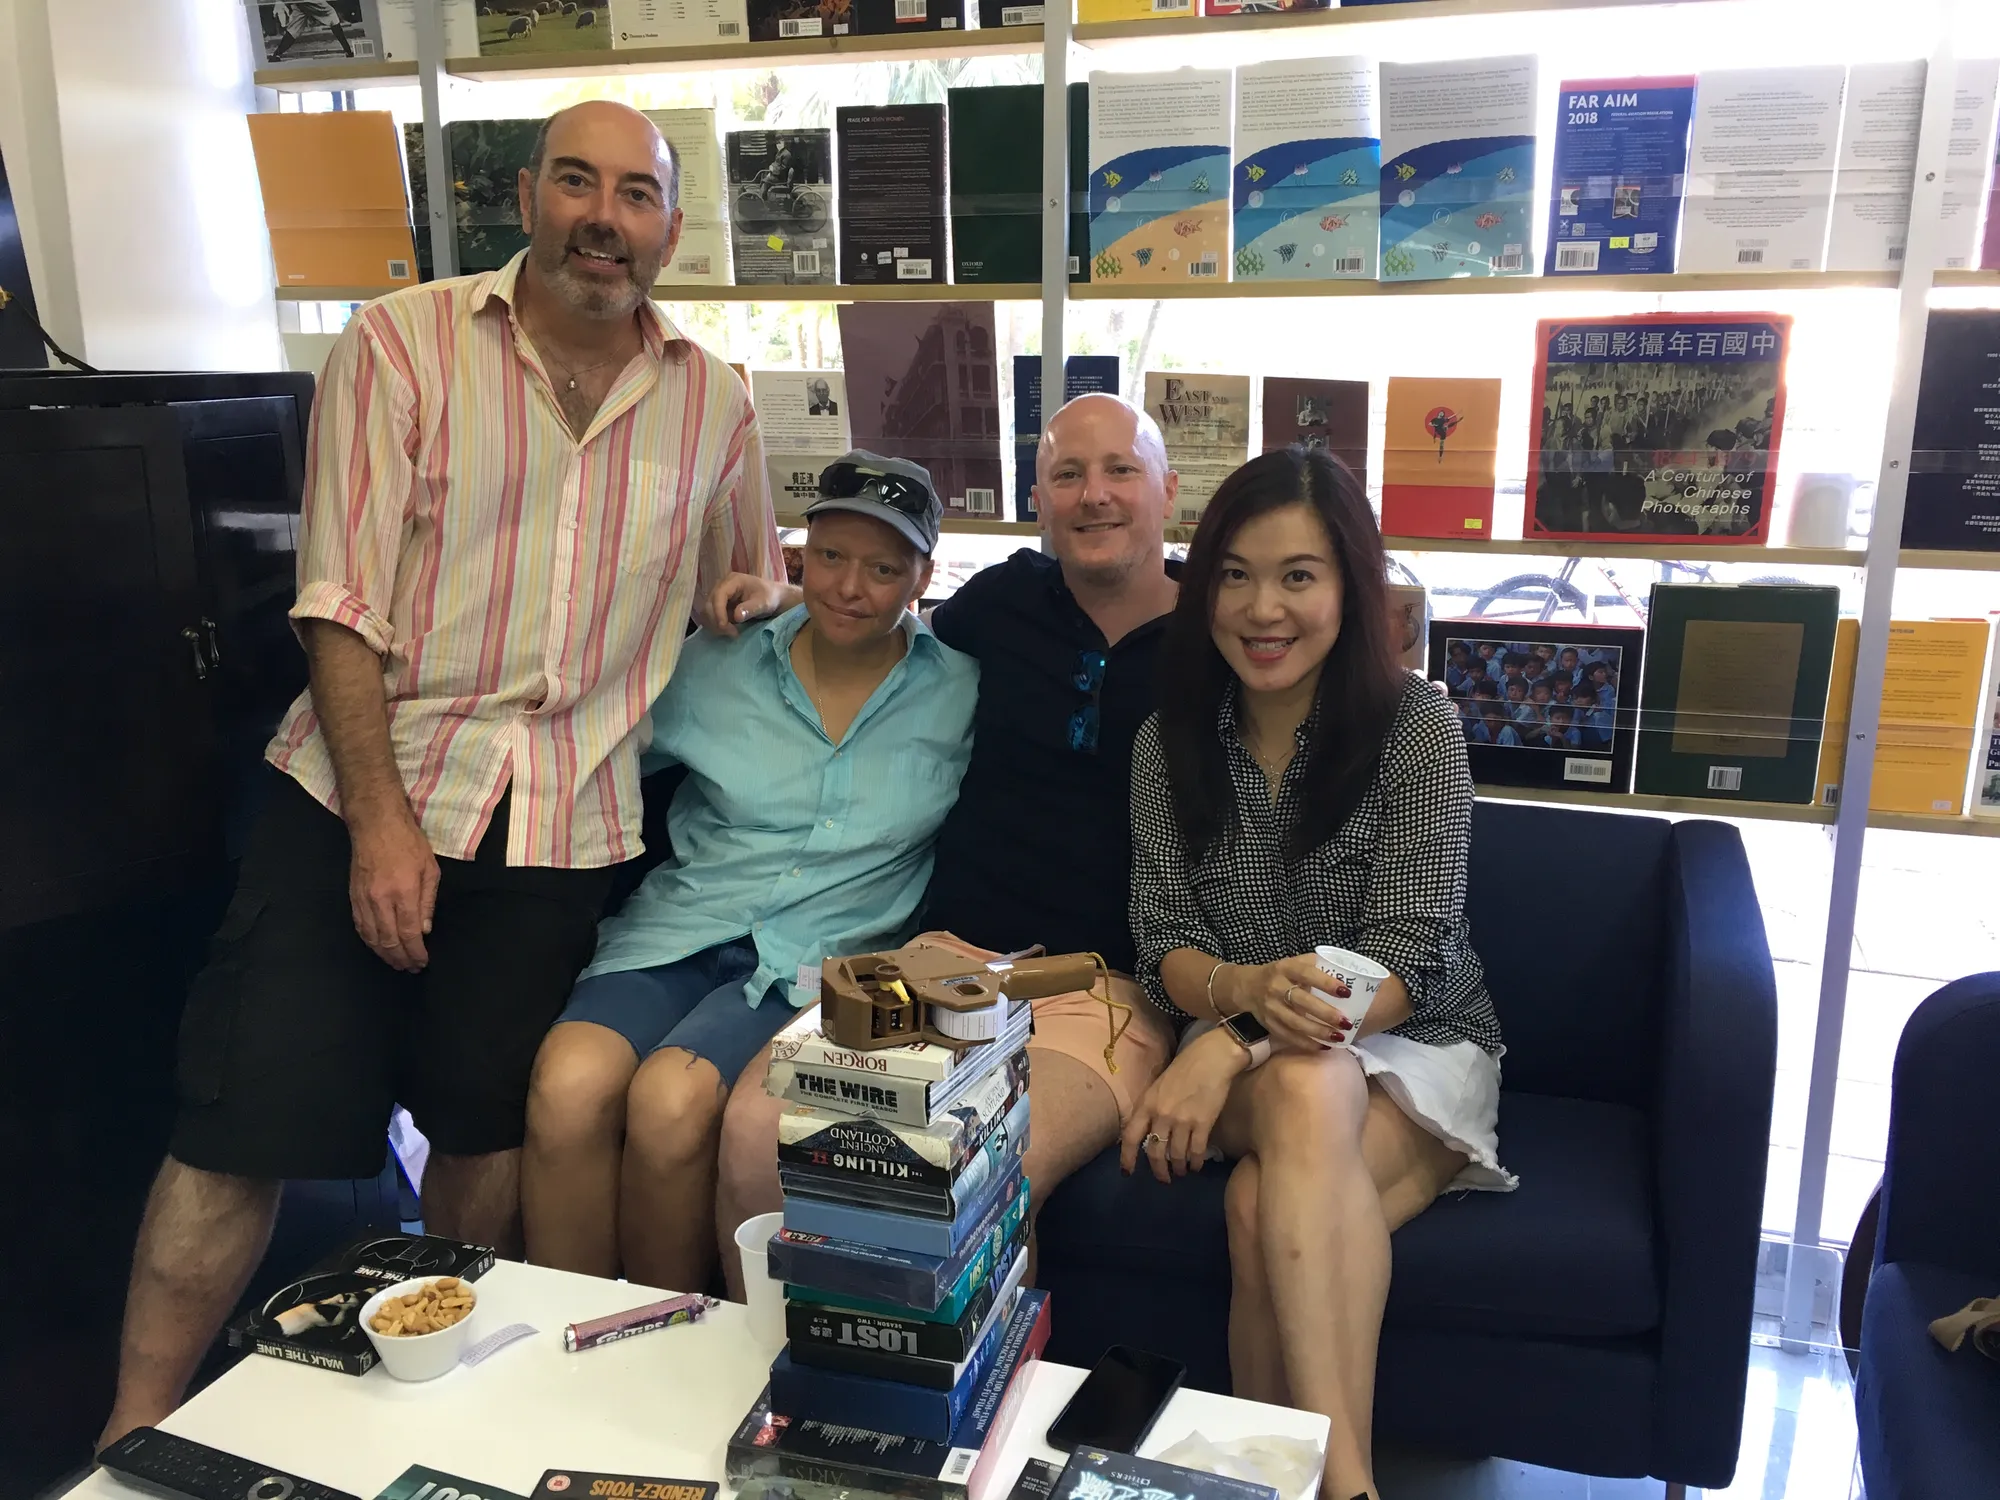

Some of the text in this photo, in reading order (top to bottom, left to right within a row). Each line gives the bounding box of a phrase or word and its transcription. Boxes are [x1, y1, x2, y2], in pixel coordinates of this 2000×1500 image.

[1568, 93, 1638, 109] FAR AIM
[1567, 112, 1598, 125] 2018
[1164, 378, 1210, 402] EAST
[1159, 404, 1211, 425] WEST
[1644, 469, 1755, 484] A Century of
[1683, 486, 1752, 499] Chinese
[1640, 500, 1751, 516] Photographs
[823, 1050, 887, 1072] BORGEN
[796, 1071, 898, 1108] THE WIRE
[814, 1092, 849, 1104] COMPLETE
[850, 1100, 869, 1108] FIRST
[871, 1104, 898, 1114] SEASON
[980, 1105, 1006, 1146] KILLING
[830, 1127, 897, 1147] SCOTLAND
[840, 1139, 887, 1155] ANCIENT
[833, 1153, 908, 1178] KILLING
[354, 1266, 406, 1281] THE LINE
[1014, 1310, 1025, 1323] AND
[1023, 1301, 1038, 1322] KNOCK
[857, 1317, 871, 1325] TWO
[878, 1320, 902, 1329] SEASON
[836, 1322, 918, 1354] LOST
[1012, 1321, 1031, 1349] YOURSELF
[256, 1343, 344, 1371] WALK THE LINE
[1005, 1349, 1017, 1363] OUT
[999, 1363, 1012, 1380] WITH
[981, 1368, 1000, 1398] KUNG-FU
[993, 1380, 1004, 1392] 100
[971, 1398, 986, 1419] FILMS!
[1033, 1460, 1048, 1468] 2000
[1110, 1470, 1152, 1487] OTHERS
[588, 1479, 708, 1500] RENDEZ-VOUS
